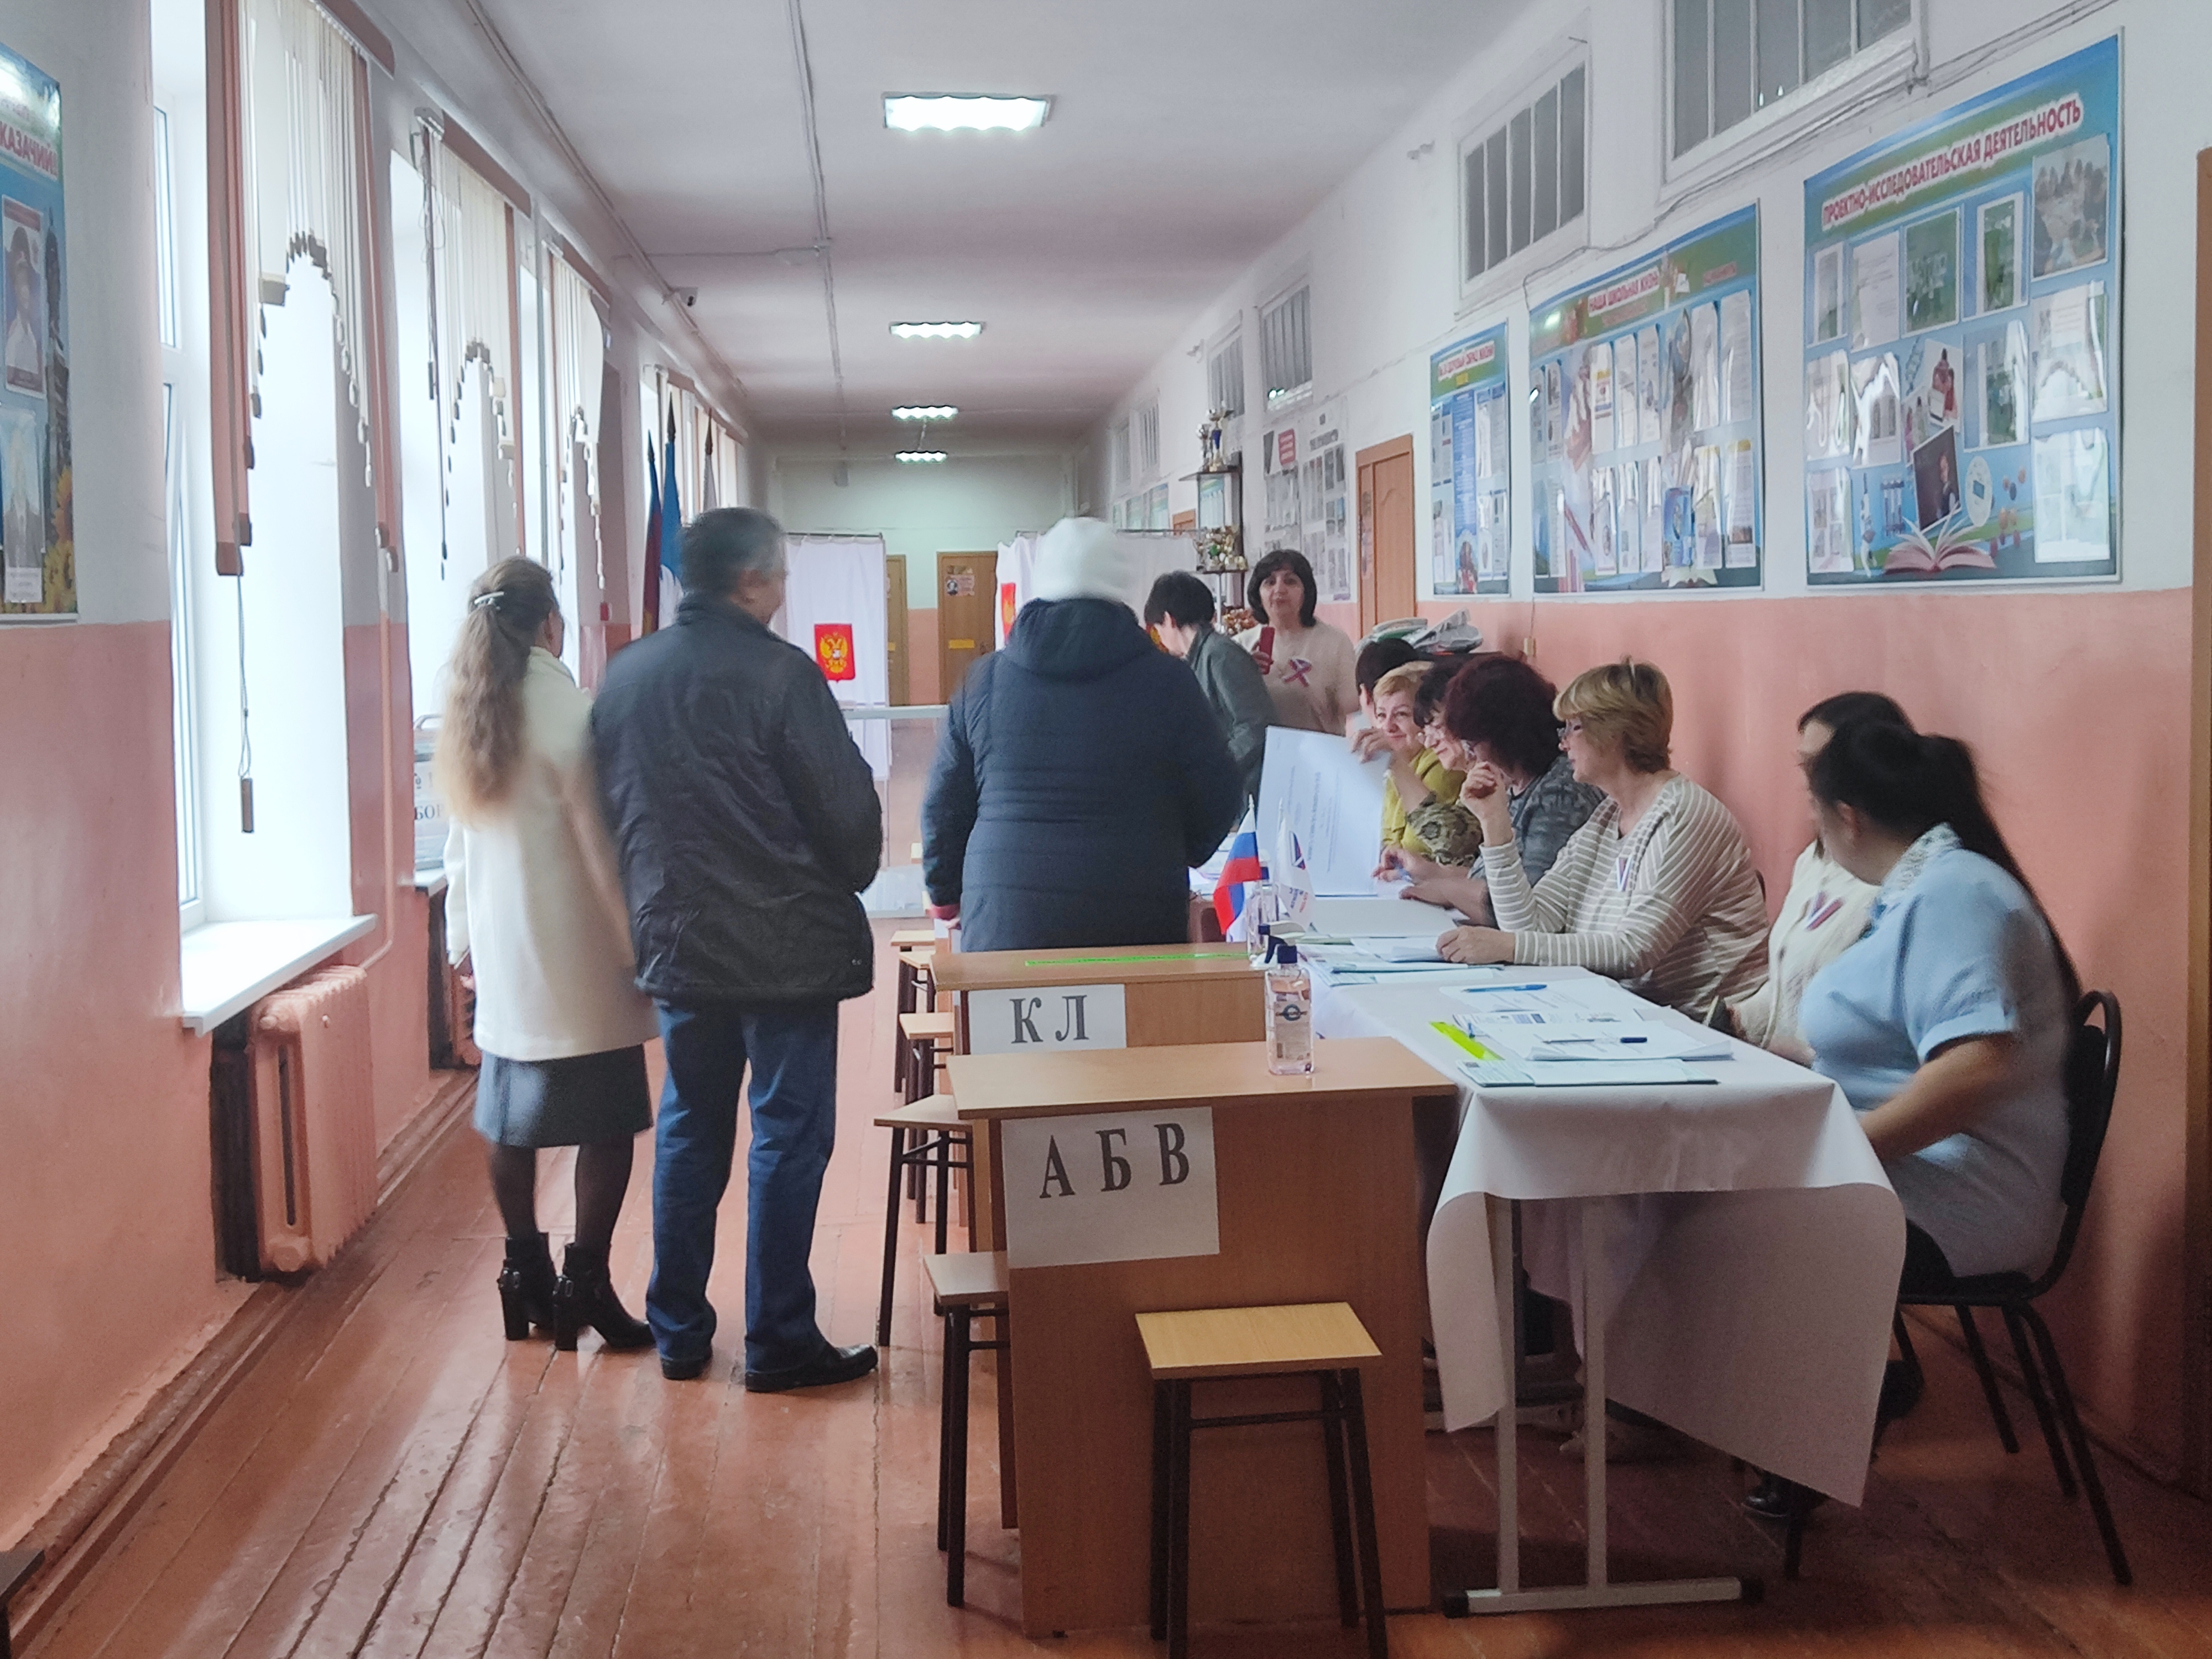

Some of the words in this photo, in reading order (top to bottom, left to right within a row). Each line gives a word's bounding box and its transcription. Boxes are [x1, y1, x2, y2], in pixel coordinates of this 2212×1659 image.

[1824, 139, 1981, 223] ПРОЕКТНО-ИССЛЕДОВАТЕЛЬСКАЯ
[1983, 100, 2081, 161] ДЕЯТЕЛЬНОСТЬ
[1040, 1135, 1076, 1198] А
[1095, 1128, 1131, 1192] Б
[1154, 1123, 1189, 1186] В
